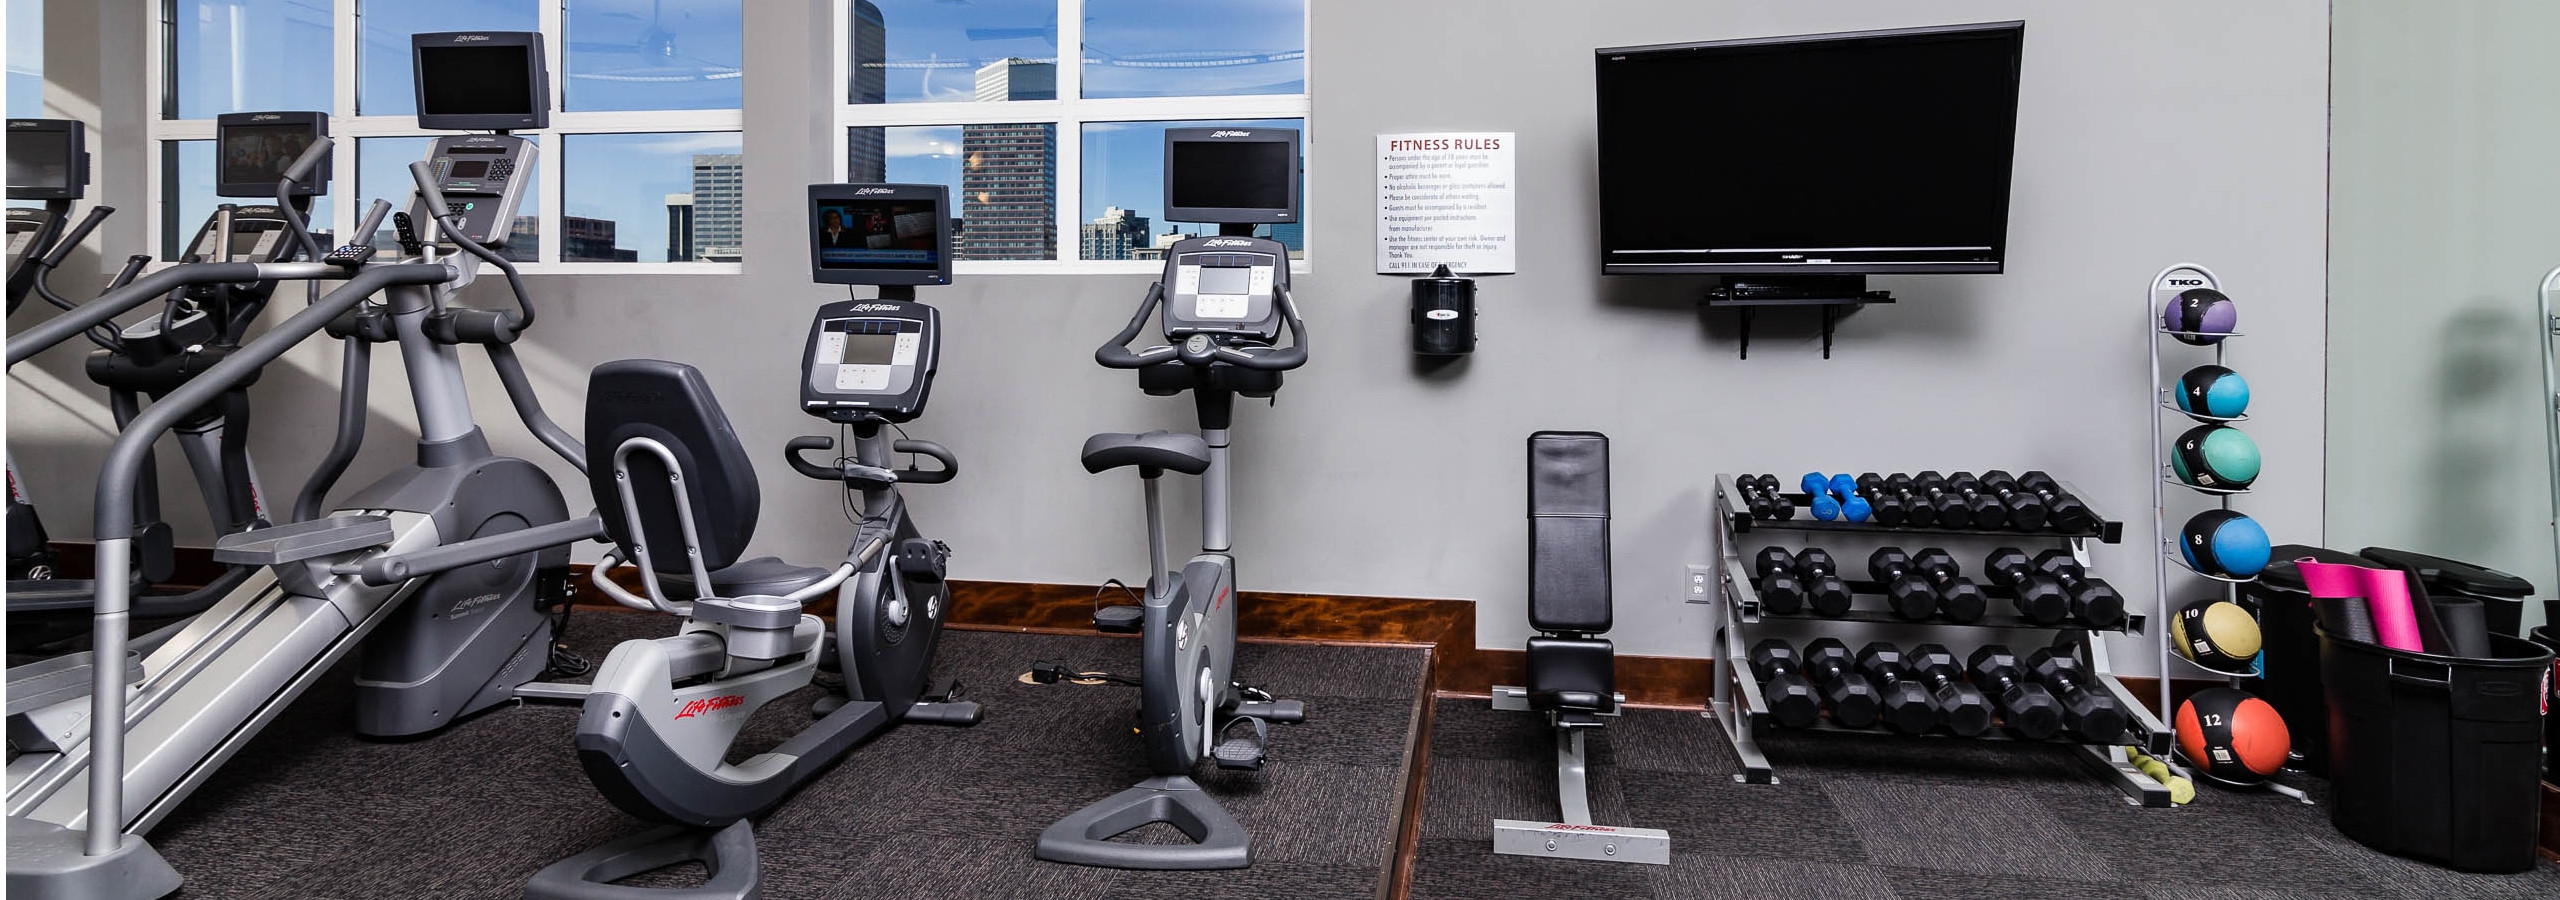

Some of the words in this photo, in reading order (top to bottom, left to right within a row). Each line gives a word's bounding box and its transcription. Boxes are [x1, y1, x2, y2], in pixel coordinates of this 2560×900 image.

[1390, 140, 1449, 151] FITNESS
[1454, 138, 1500, 150] RULES
[2190, 299, 2198, 307] 2
[2193, 386, 2200, 396] 4
[2186, 440, 2194, 449] 6
[2195, 534, 2202, 545] 8
[2185, 609, 2198, 619] 10
[674, 698, 705, 720] Life
[702, 695, 745, 716] Fitness
[2204, 714, 2222, 726] 12
